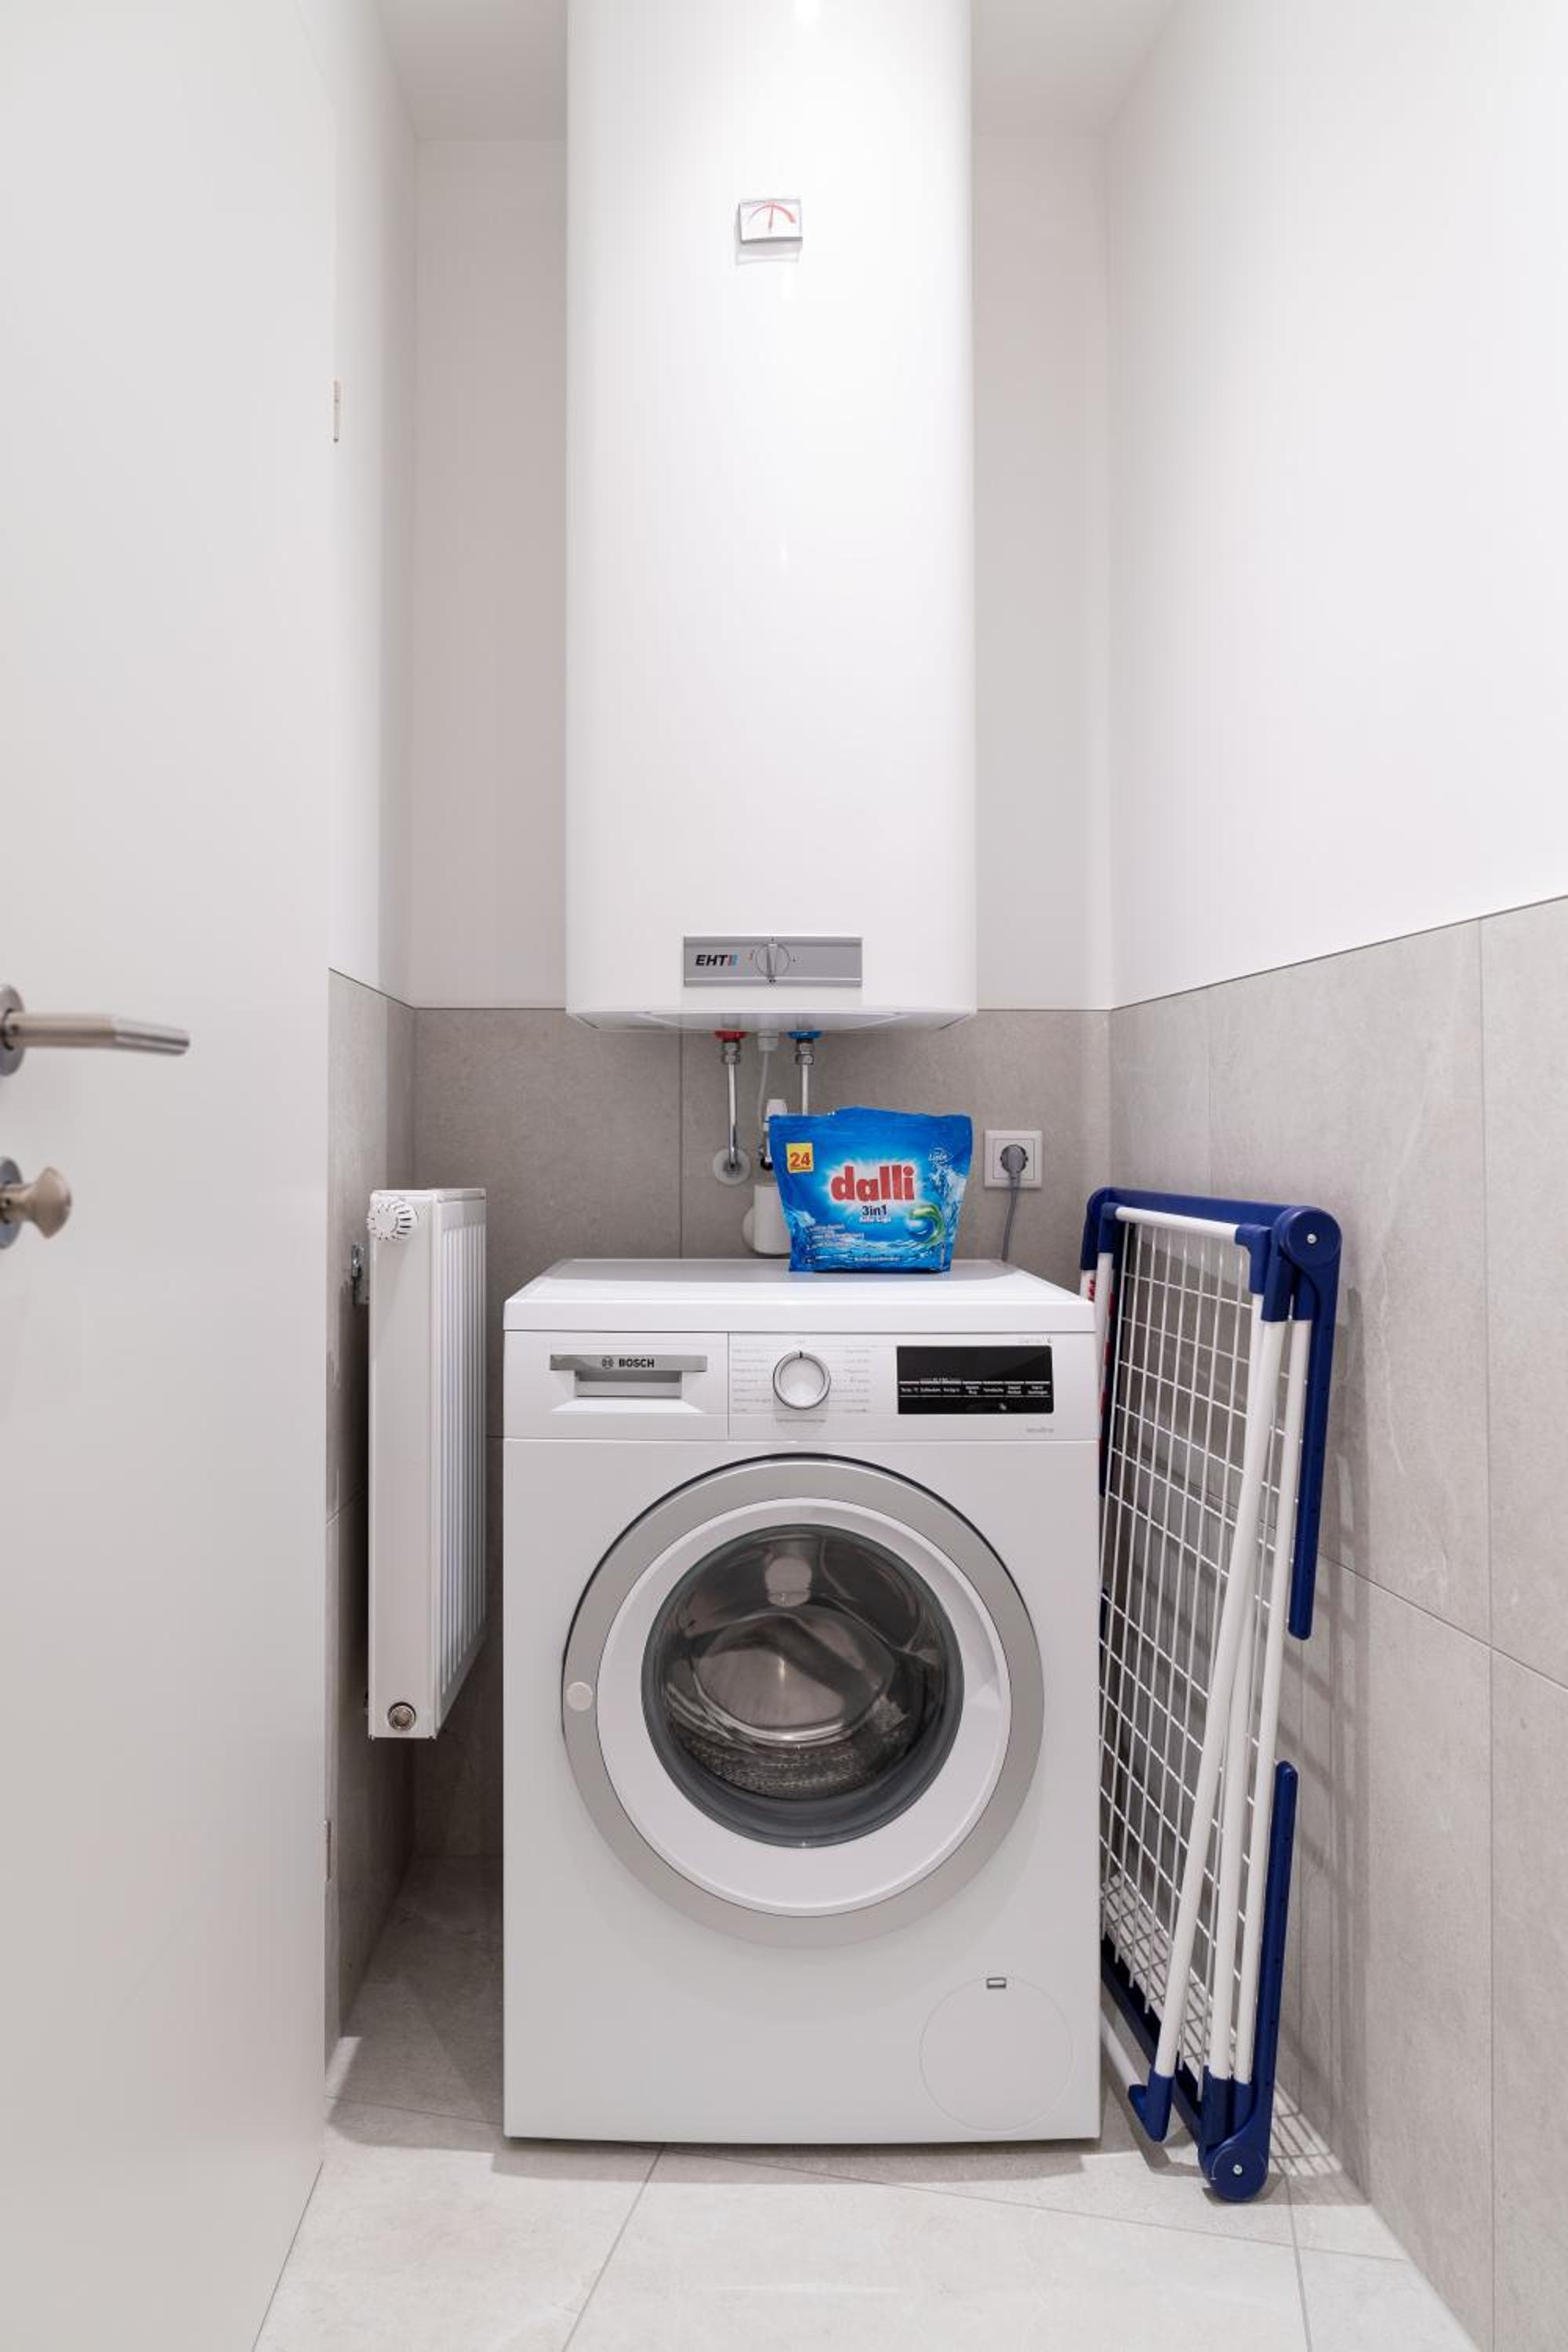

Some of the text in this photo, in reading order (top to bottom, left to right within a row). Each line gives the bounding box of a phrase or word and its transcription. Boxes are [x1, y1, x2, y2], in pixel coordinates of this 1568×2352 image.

[789, 1152, 811, 1167] 24
[831, 1164, 915, 1201] dalli
[862, 1204, 887, 1216] 3in1
[619, 1358, 655, 1368] BOSCH
